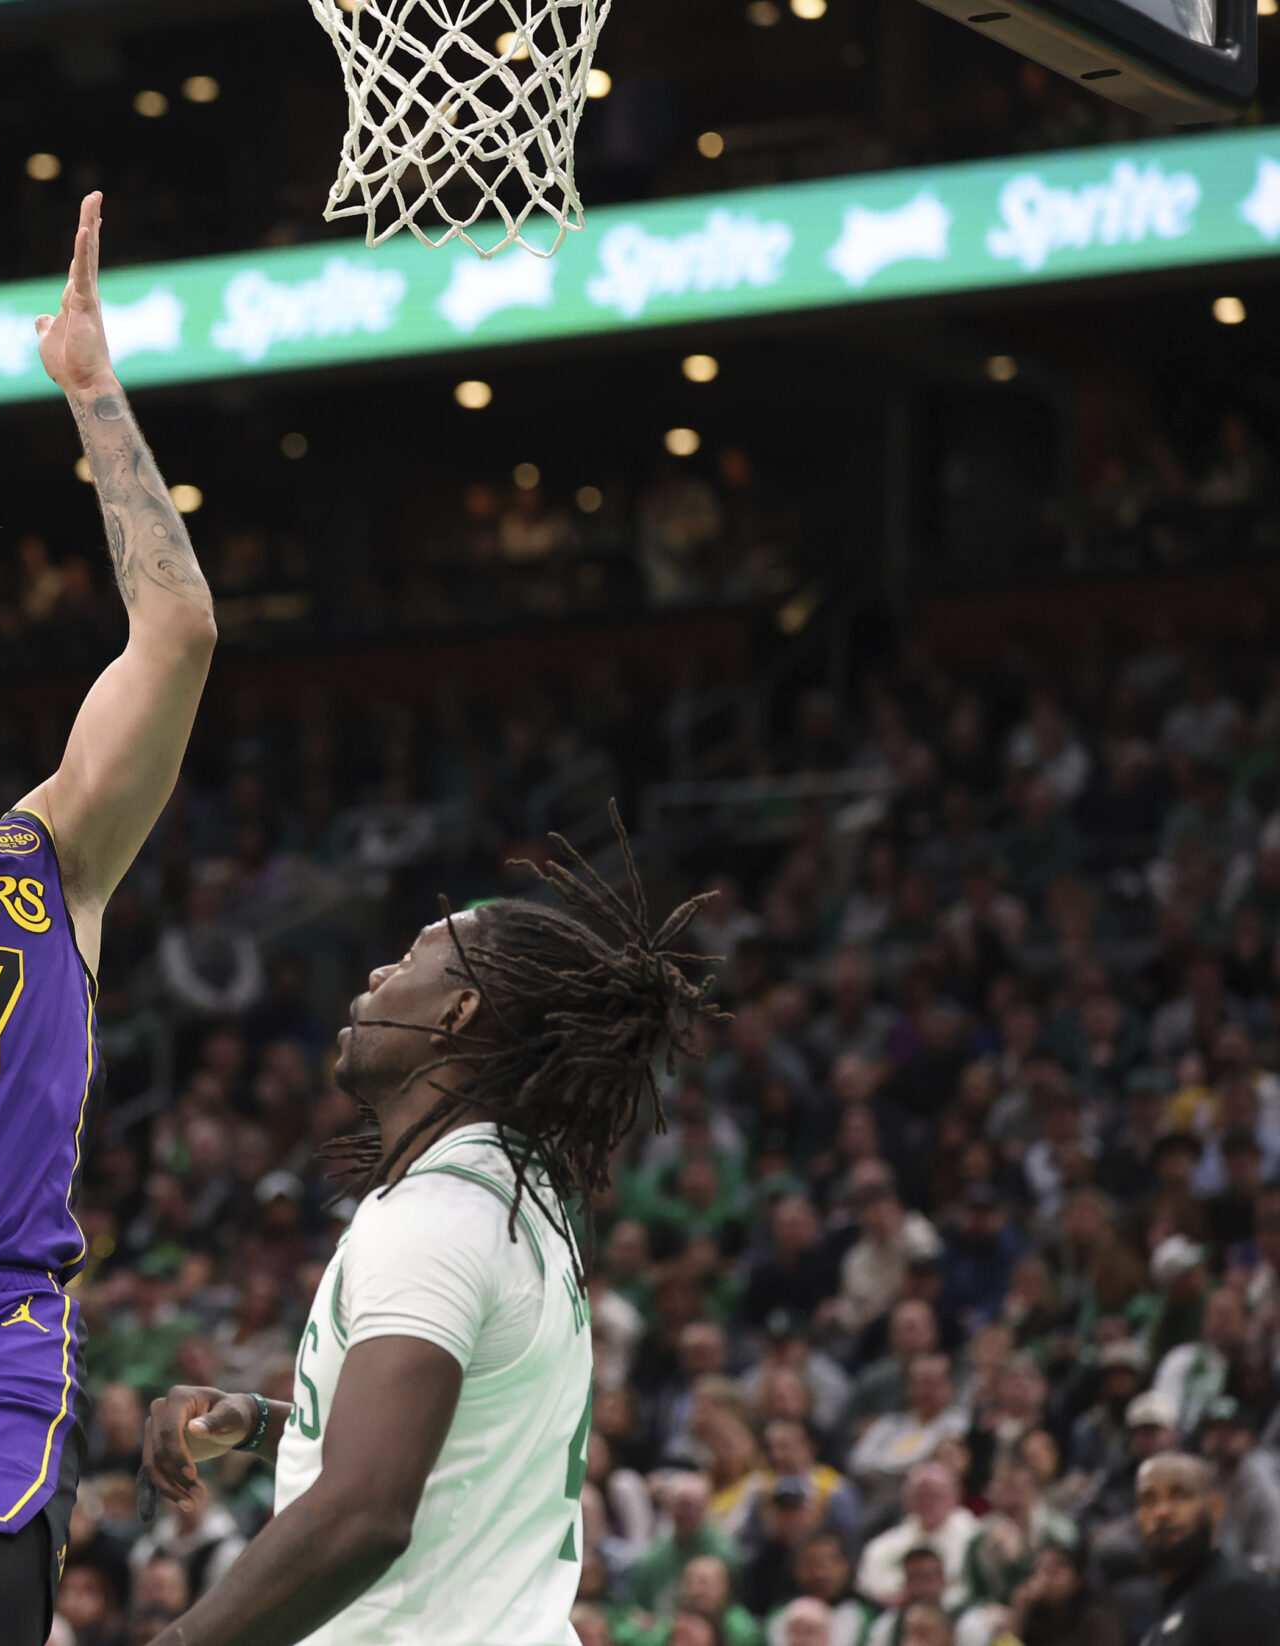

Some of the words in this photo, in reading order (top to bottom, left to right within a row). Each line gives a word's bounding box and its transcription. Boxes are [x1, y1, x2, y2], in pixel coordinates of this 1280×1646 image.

[210, 257, 408, 362] Sprite
[586, 209, 793, 318] Sprite
[986, 161, 1201, 271] Sprite
